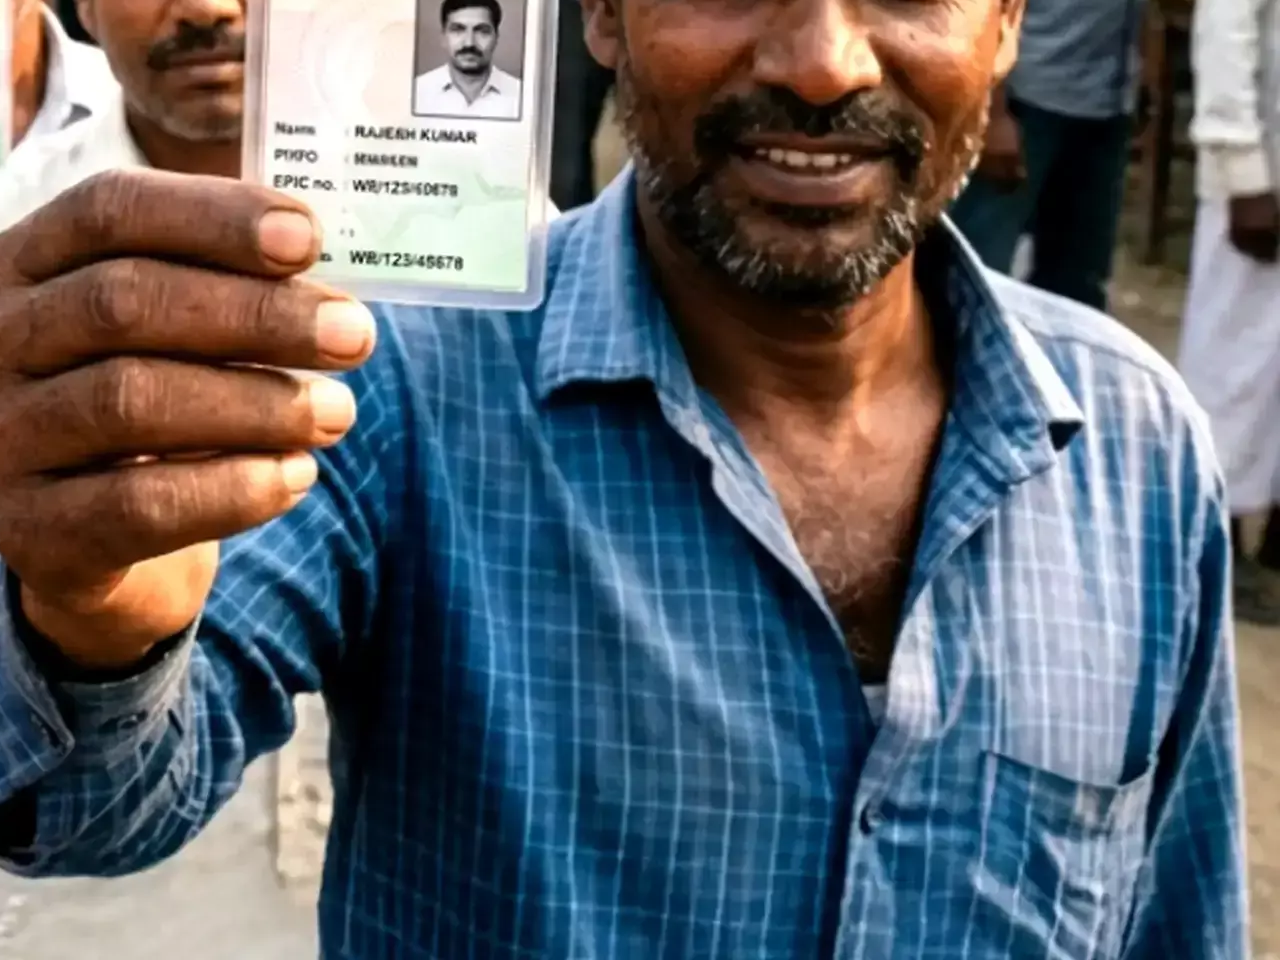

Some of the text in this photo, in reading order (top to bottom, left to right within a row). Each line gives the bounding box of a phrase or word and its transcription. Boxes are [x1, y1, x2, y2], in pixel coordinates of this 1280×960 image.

[420, 127, 478, 144] KUMAR
[273, 174, 337, 191] EPIC no.
